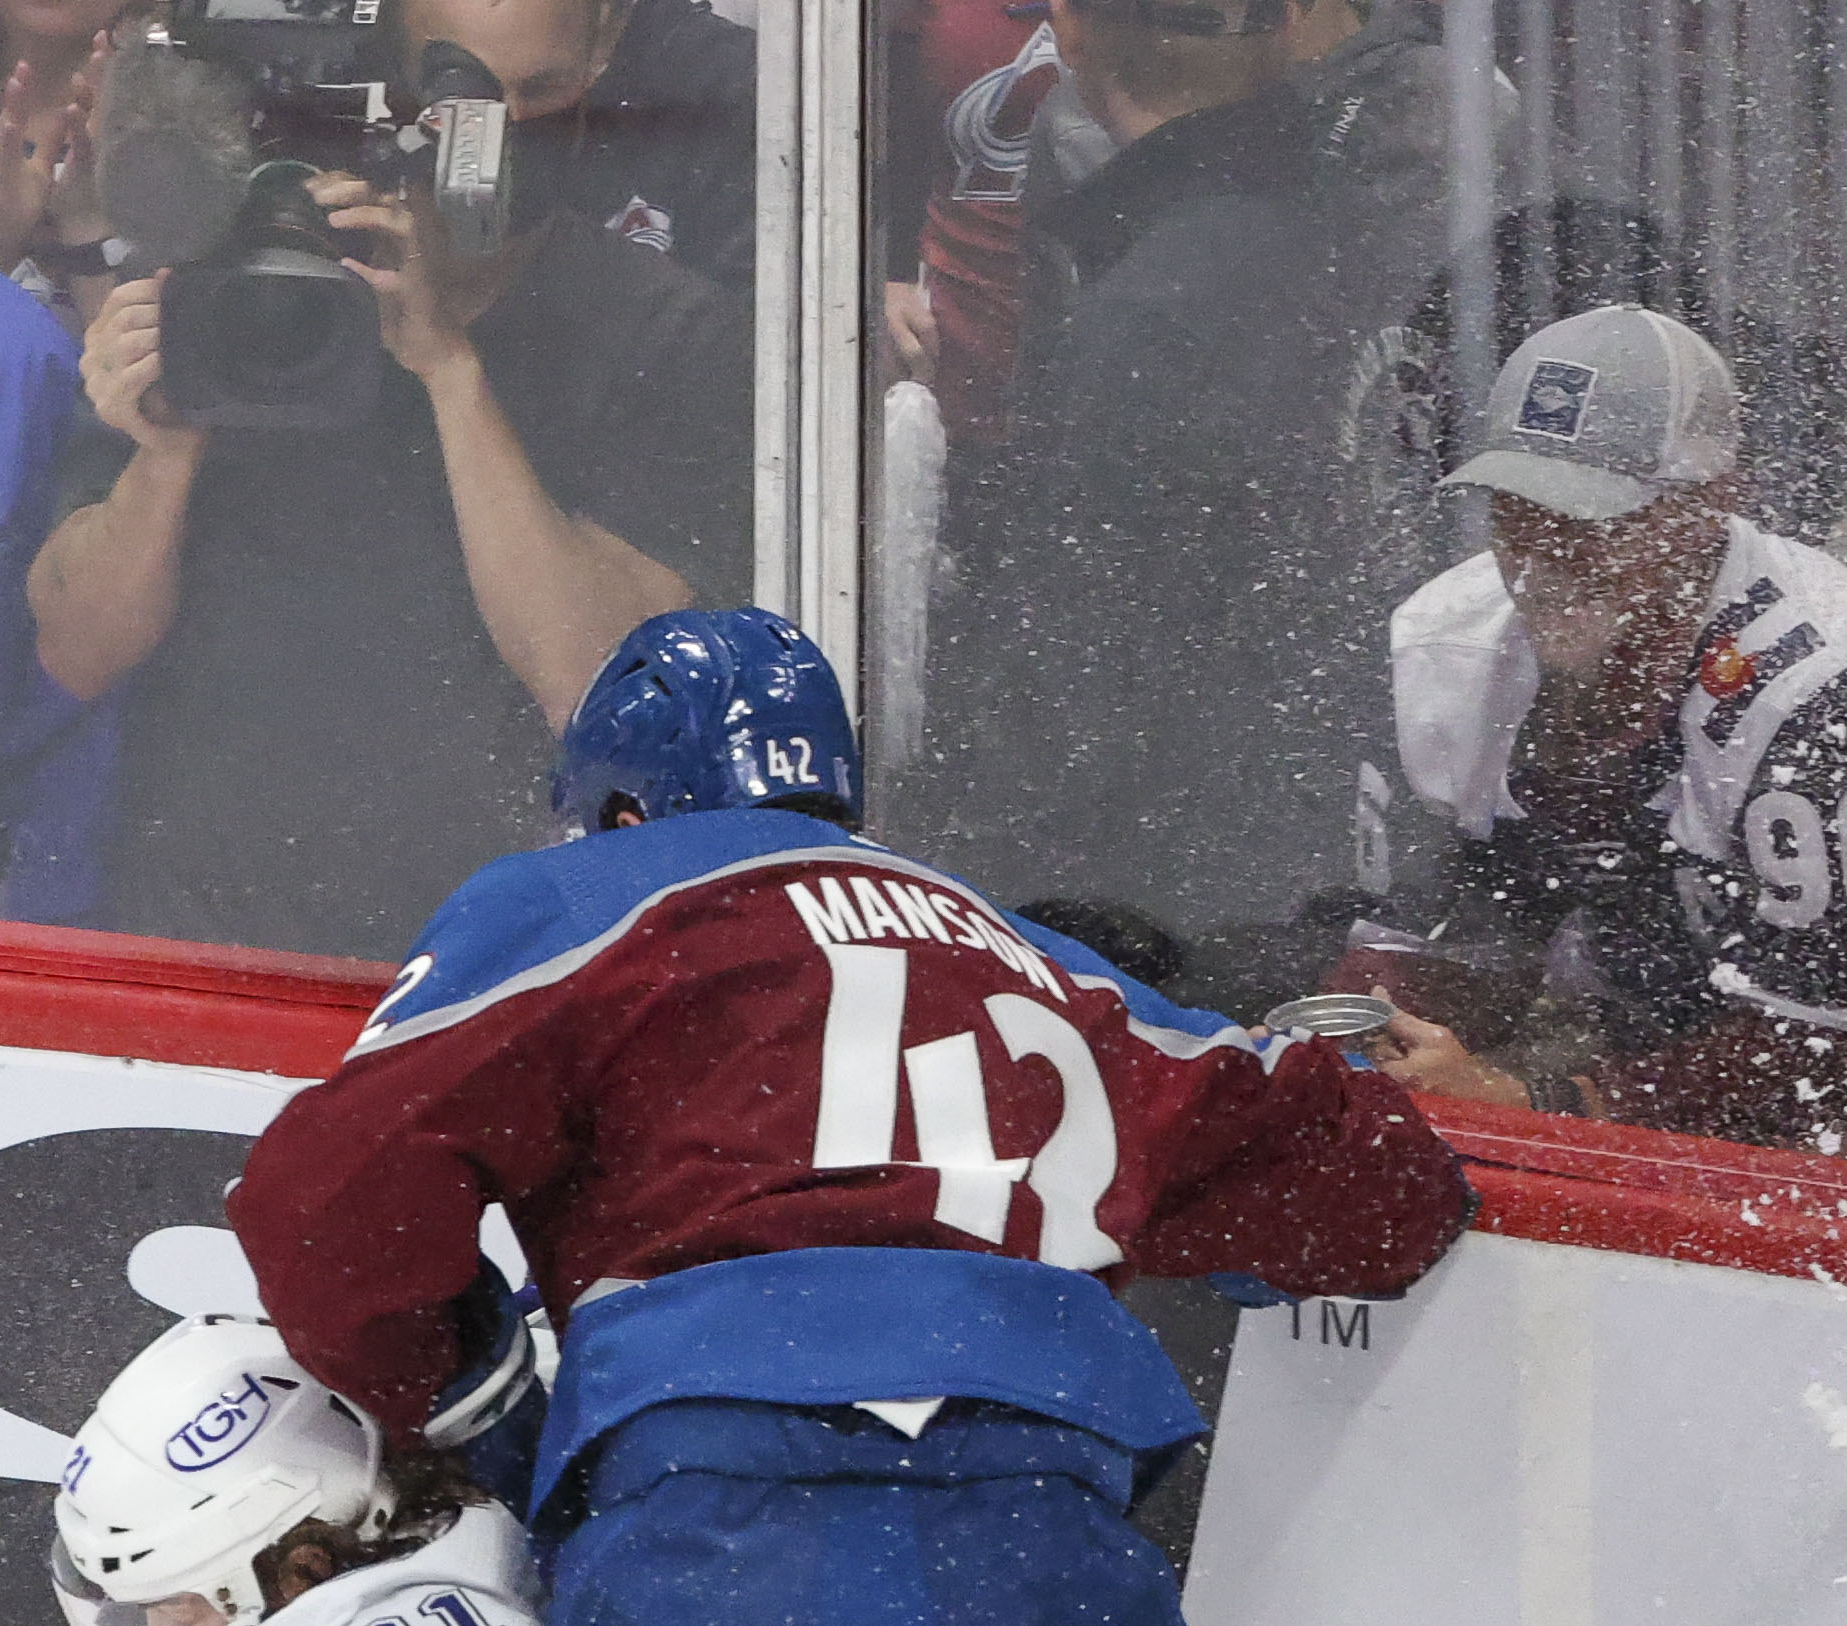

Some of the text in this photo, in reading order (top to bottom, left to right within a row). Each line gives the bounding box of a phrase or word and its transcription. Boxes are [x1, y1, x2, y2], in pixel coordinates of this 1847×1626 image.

[766, 736, 820, 784] 42
[784, 876, 1069, 1004] MANSON
[812, 944, 1125, 1272] 42
[169, 1372, 269, 1458] TGH
